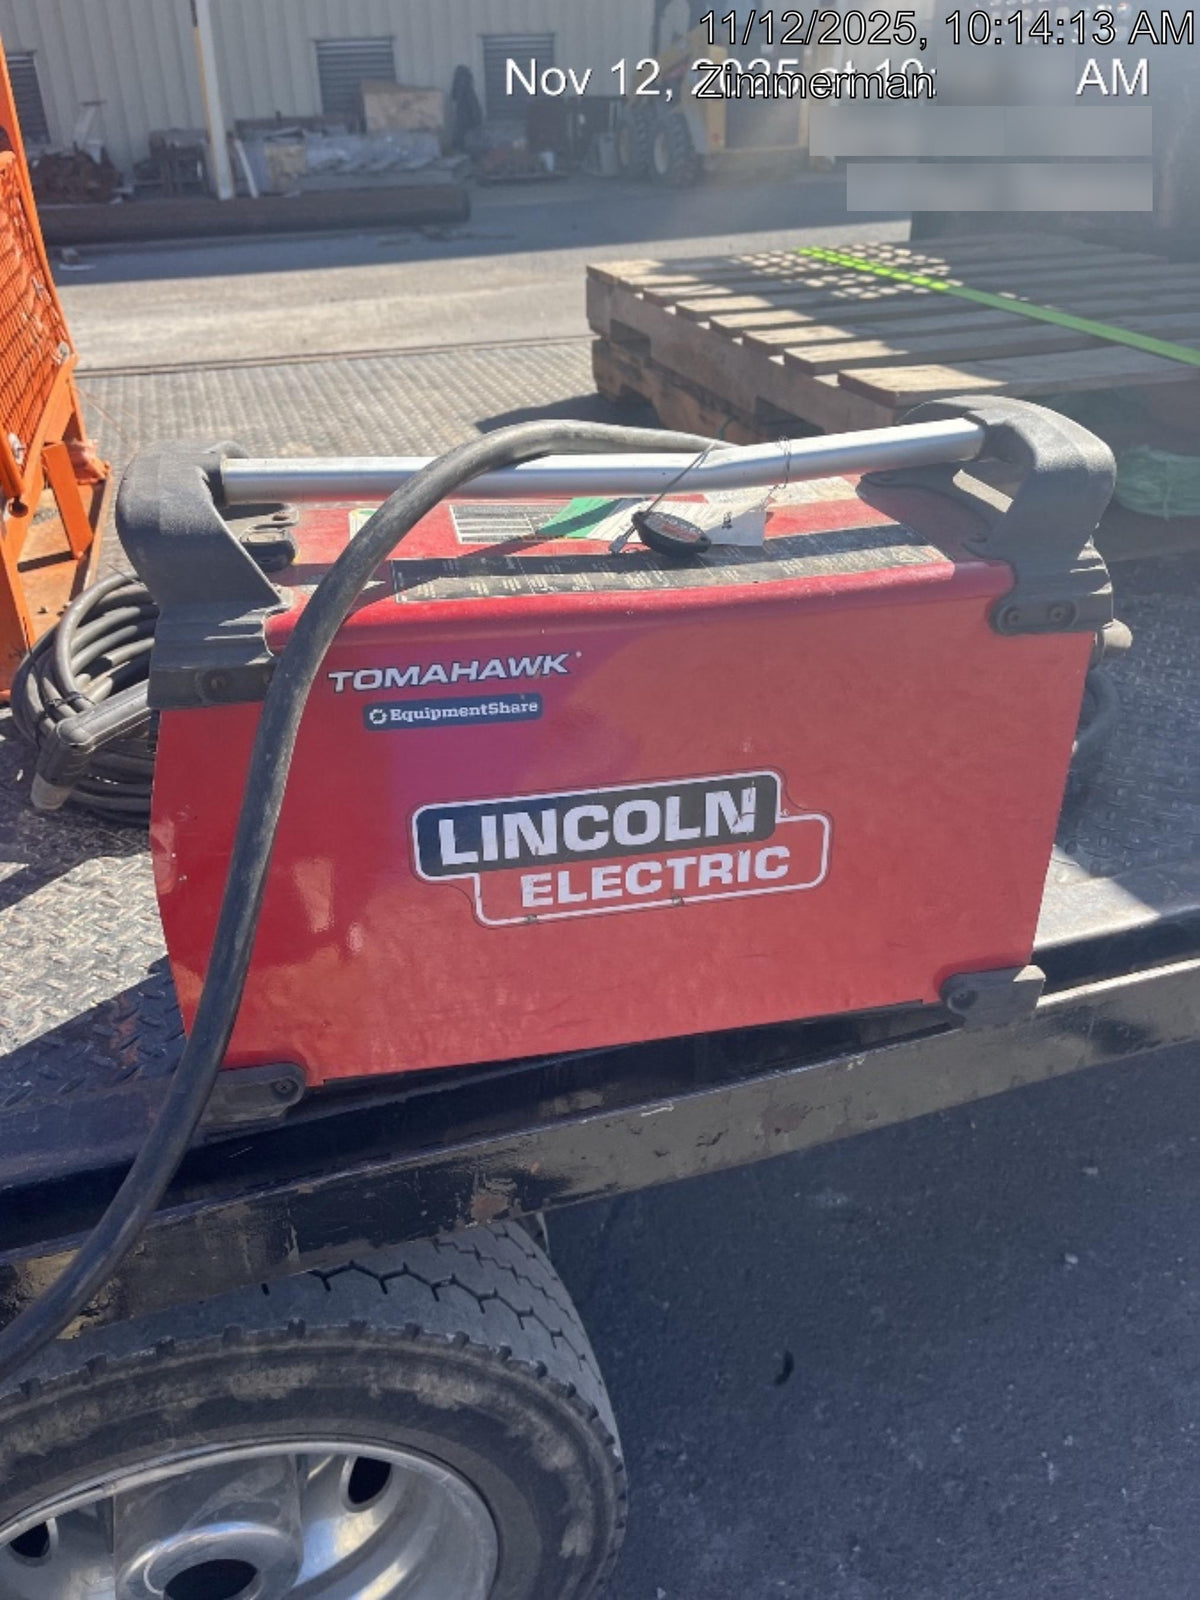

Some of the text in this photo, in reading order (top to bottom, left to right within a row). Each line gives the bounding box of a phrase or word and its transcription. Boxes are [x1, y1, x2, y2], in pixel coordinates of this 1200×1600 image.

[328, 652, 570, 693] TOMAHAWK
[389, 700, 539, 723] EquipmentShare
[438, 783, 757, 867] LINCOLN
[519, 845, 791, 909] ELECTRIC
